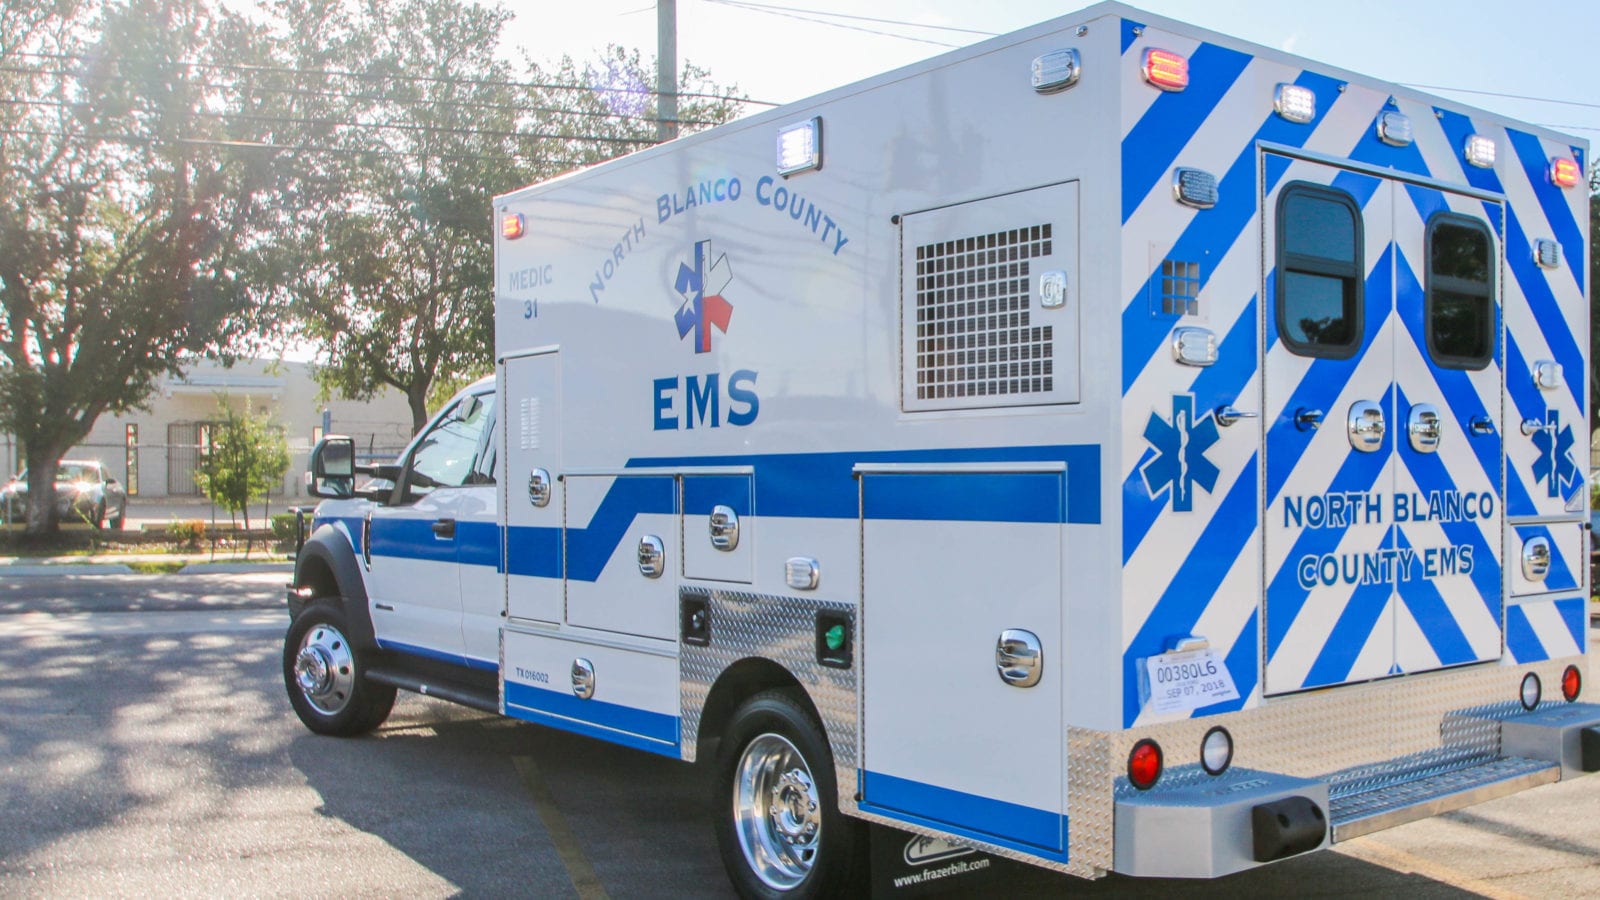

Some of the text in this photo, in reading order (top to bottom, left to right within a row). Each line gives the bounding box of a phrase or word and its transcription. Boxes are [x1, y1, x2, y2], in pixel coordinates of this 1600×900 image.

[588, 175, 849, 303] NORTH BLANCO COUNTY
[508, 264, 553, 291] MEDIC
[523, 298, 538, 320] 31
[653, 369, 760, 431] EMS
[1283, 490, 1494, 528] NORTH BLANCO
[1298, 545, 1474, 589] COUNTY EMS
[1157, 660, 1217, 683] 00380L6
[1166, 688, 1182, 698] SEP
[1201, 679, 1225, 692] 2018
[893, 858, 990, 888] www.frazerbilt.com
